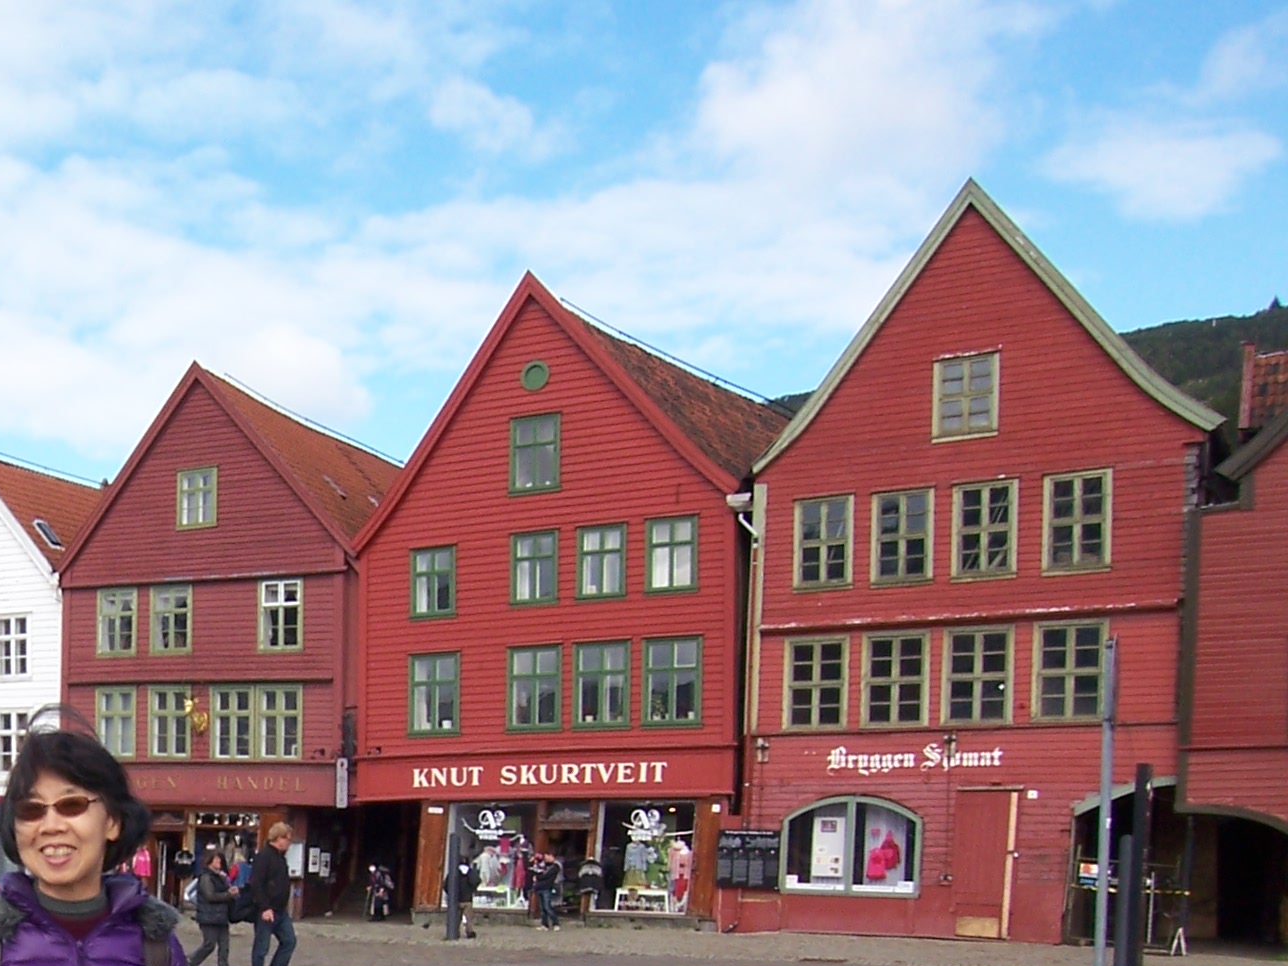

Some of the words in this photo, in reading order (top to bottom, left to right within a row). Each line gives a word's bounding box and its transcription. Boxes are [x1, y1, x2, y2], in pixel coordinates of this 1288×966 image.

[826, 745, 915, 776] Bryggen
[135, 774, 180, 790] GEN
[215, 774, 307, 793] HANDEL
[412, 766, 484, 788] KNUT
[499, 761, 668, 786] SKURTVEIT
